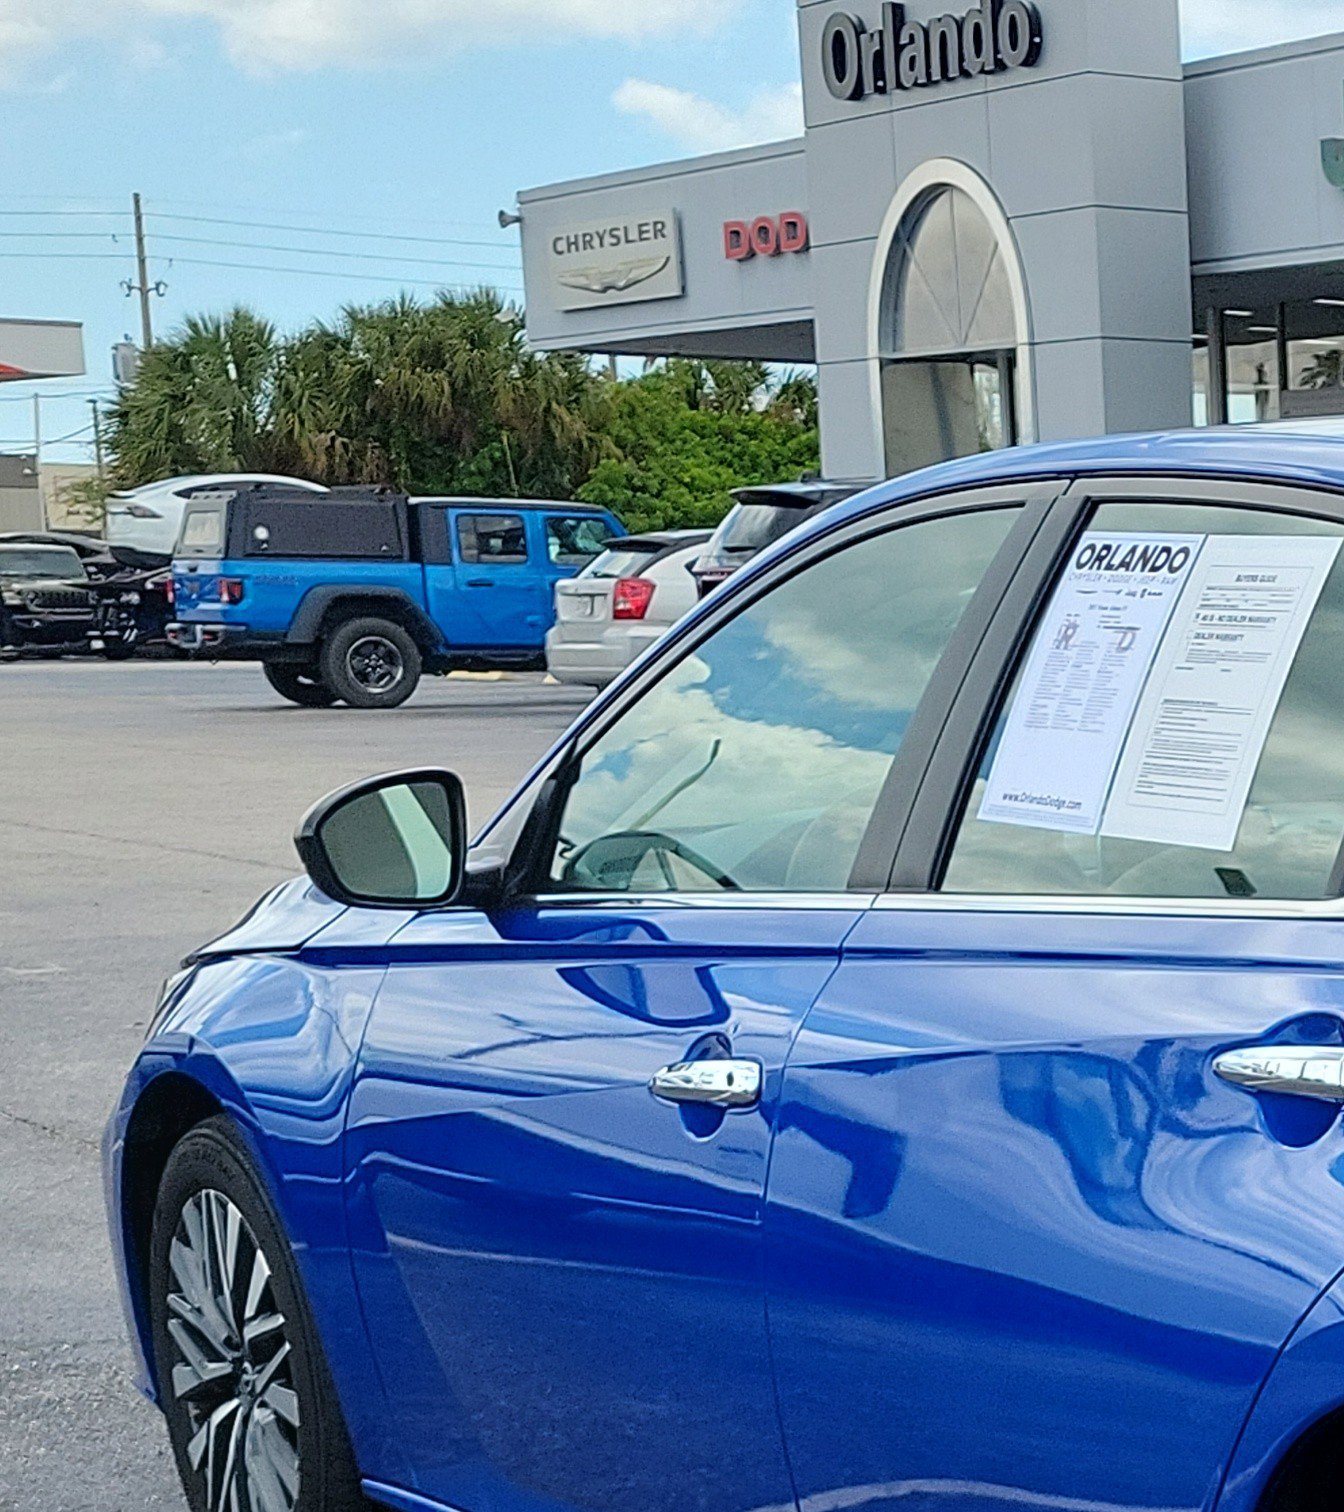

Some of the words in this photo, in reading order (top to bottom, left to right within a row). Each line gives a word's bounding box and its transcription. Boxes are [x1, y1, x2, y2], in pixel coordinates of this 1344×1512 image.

[821, 0, 1042, 101] Orlando
[552, 220, 667, 256] CHRYSLER
[723, 211, 810, 261] DOD
[1075, 543, 1191, 574] ORLANDO
